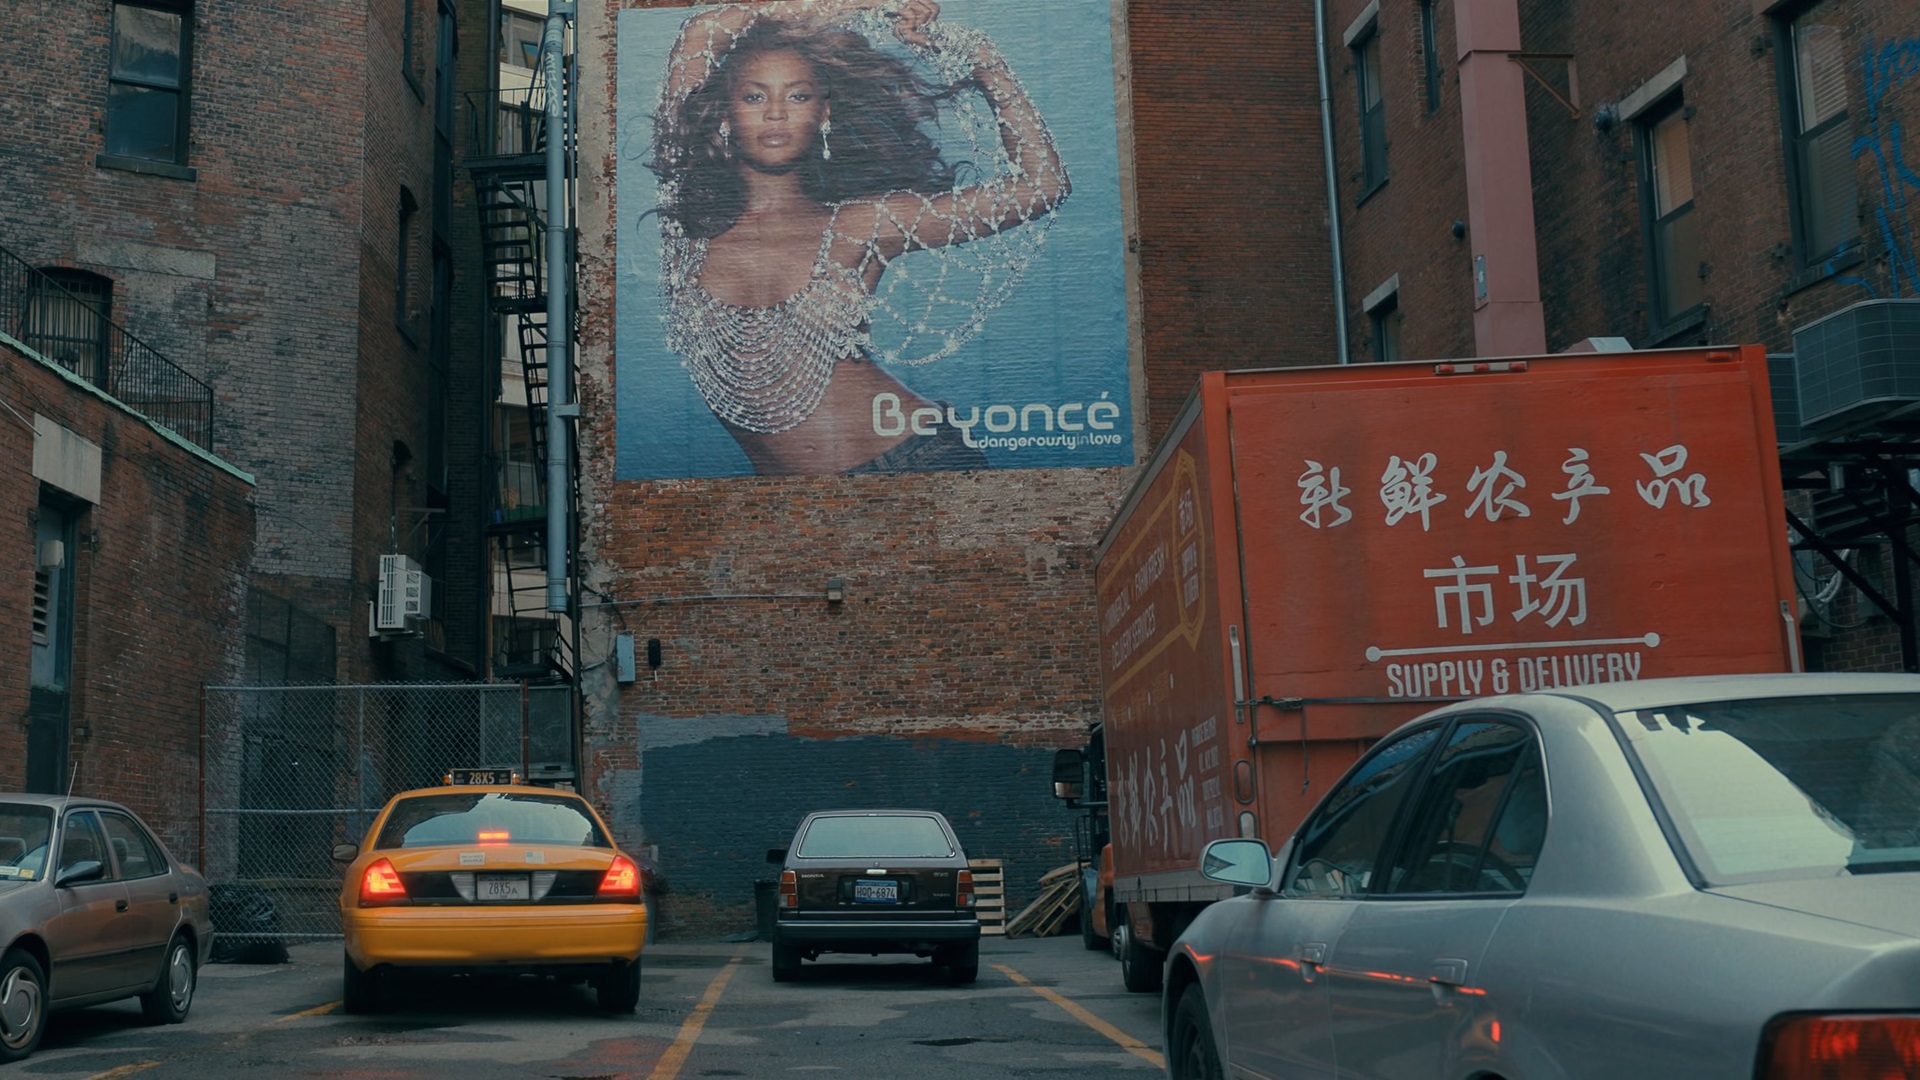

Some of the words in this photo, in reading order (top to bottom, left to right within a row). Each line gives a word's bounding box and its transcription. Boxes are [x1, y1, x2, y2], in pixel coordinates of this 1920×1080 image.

[872, 391, 1120, 448] Beyoncé
[1297, 444, 1711, 532] 新鲜农产品
[1423, 553, 1587, 634] 市场
[1386, 659, 1483, 698] SUPPLY
[1491, 658, 1510, 694] &
[1518, 652, 1641, 693] DELIVERY
[469, 772, 495, 785] 28X5
